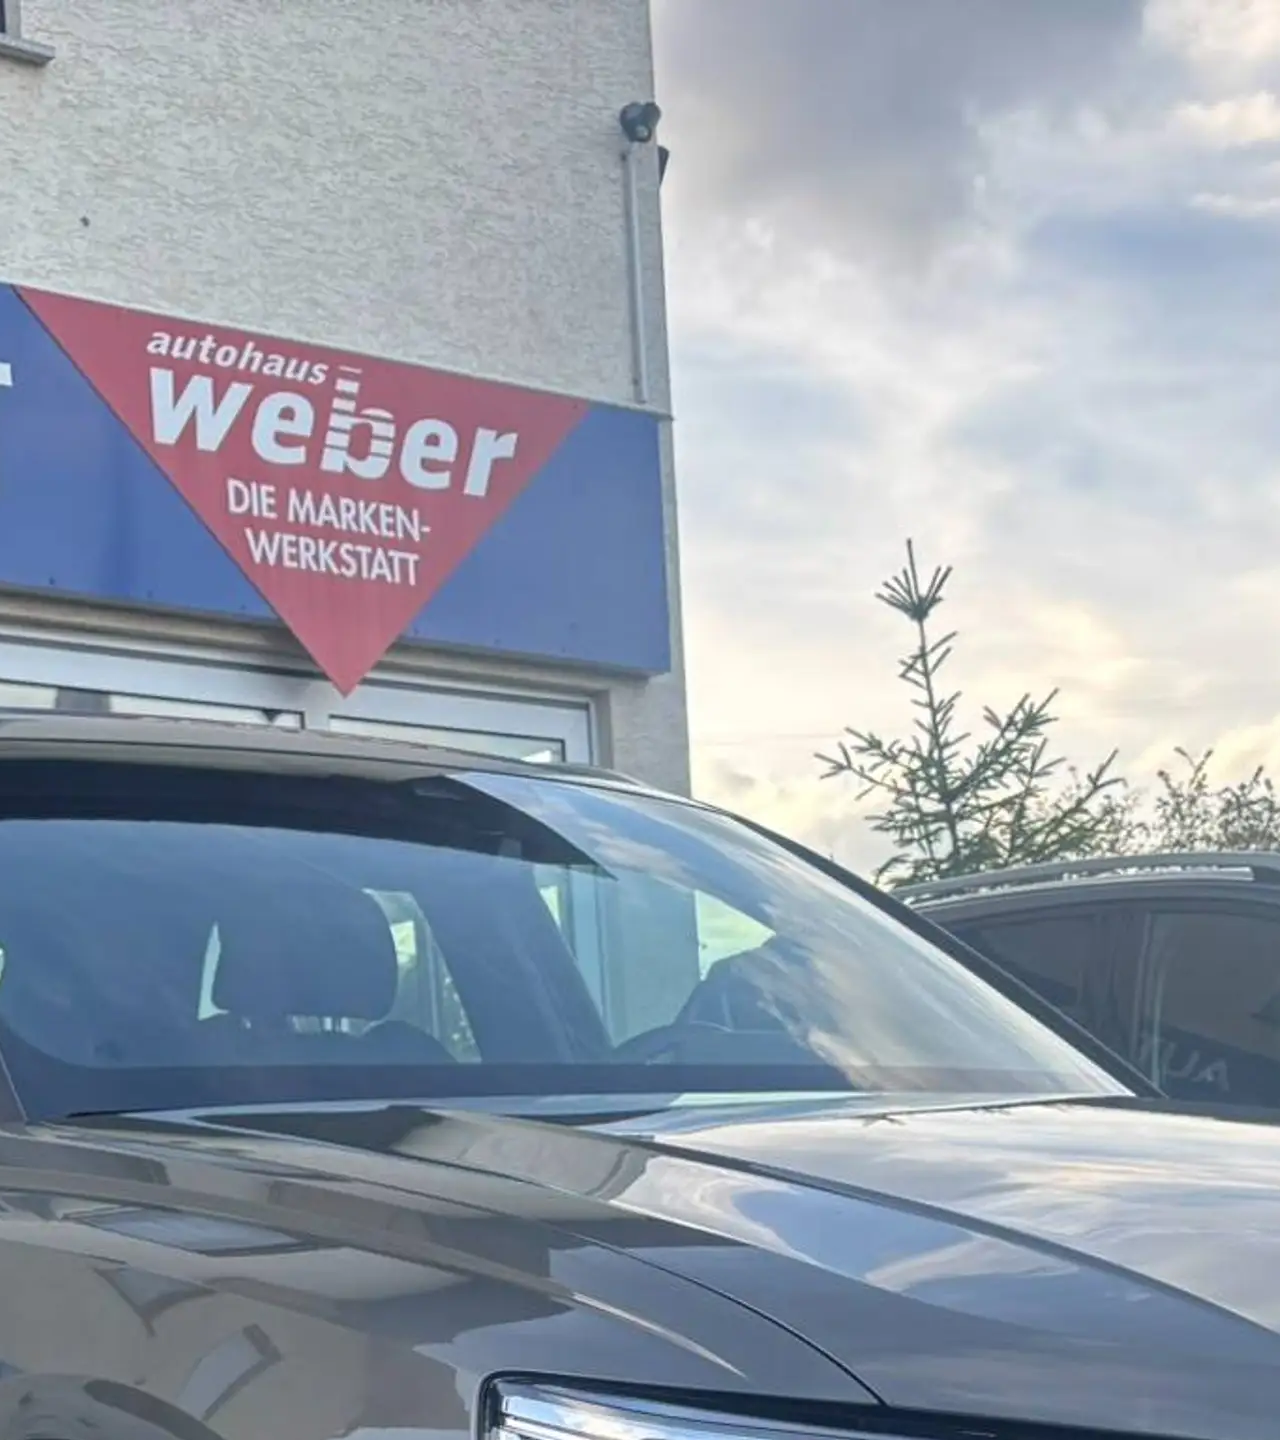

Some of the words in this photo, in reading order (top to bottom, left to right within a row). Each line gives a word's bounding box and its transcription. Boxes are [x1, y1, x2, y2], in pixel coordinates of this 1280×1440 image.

[147, 330, 329, 386] autohaus
[149, 365, 518, 497] weber
[226, 477, 279, 520] DIE
[287, 487, 432, 542] MARKEN-
[245, 526, 420, 587] WERKSTATT
